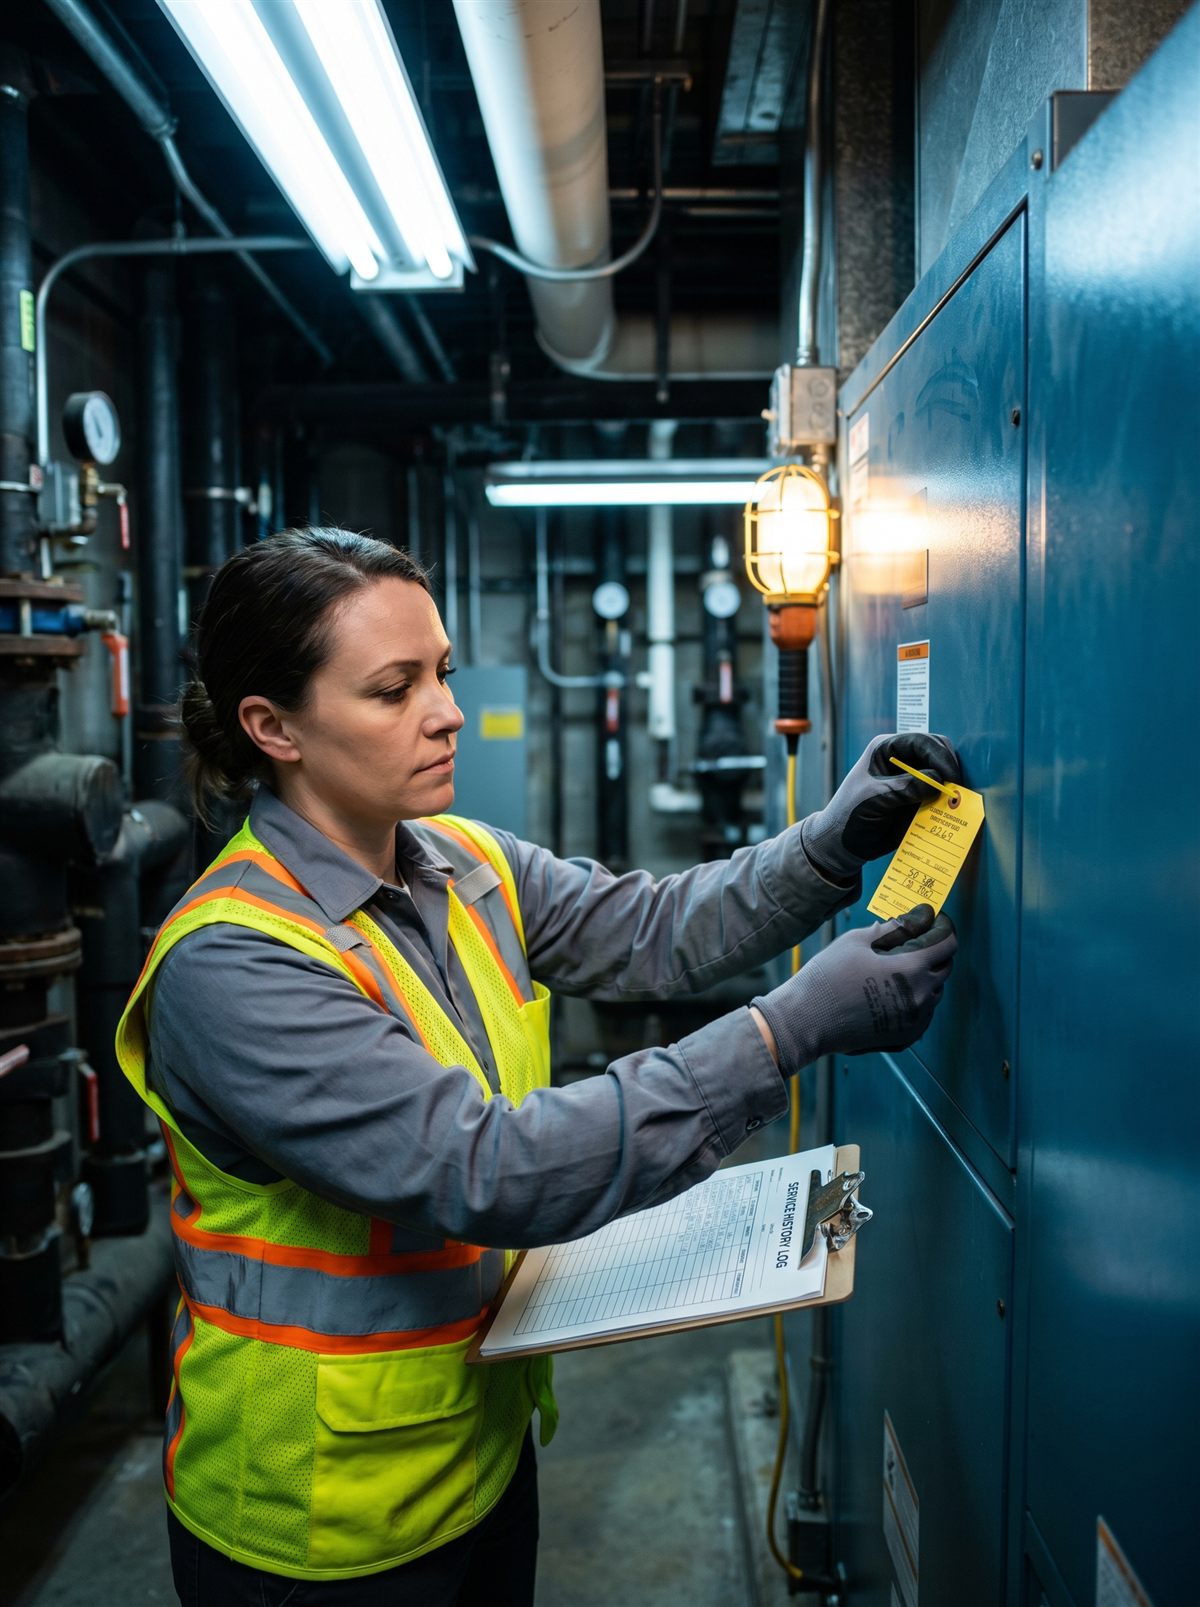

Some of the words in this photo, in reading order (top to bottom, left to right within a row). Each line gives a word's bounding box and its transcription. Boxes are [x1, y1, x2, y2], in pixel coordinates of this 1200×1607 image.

[784, 1181, 799, 1213] SERVICE
[779, 1213, 795, 1247] HISTORY
[776, 1250, 790, 1269] LOG
